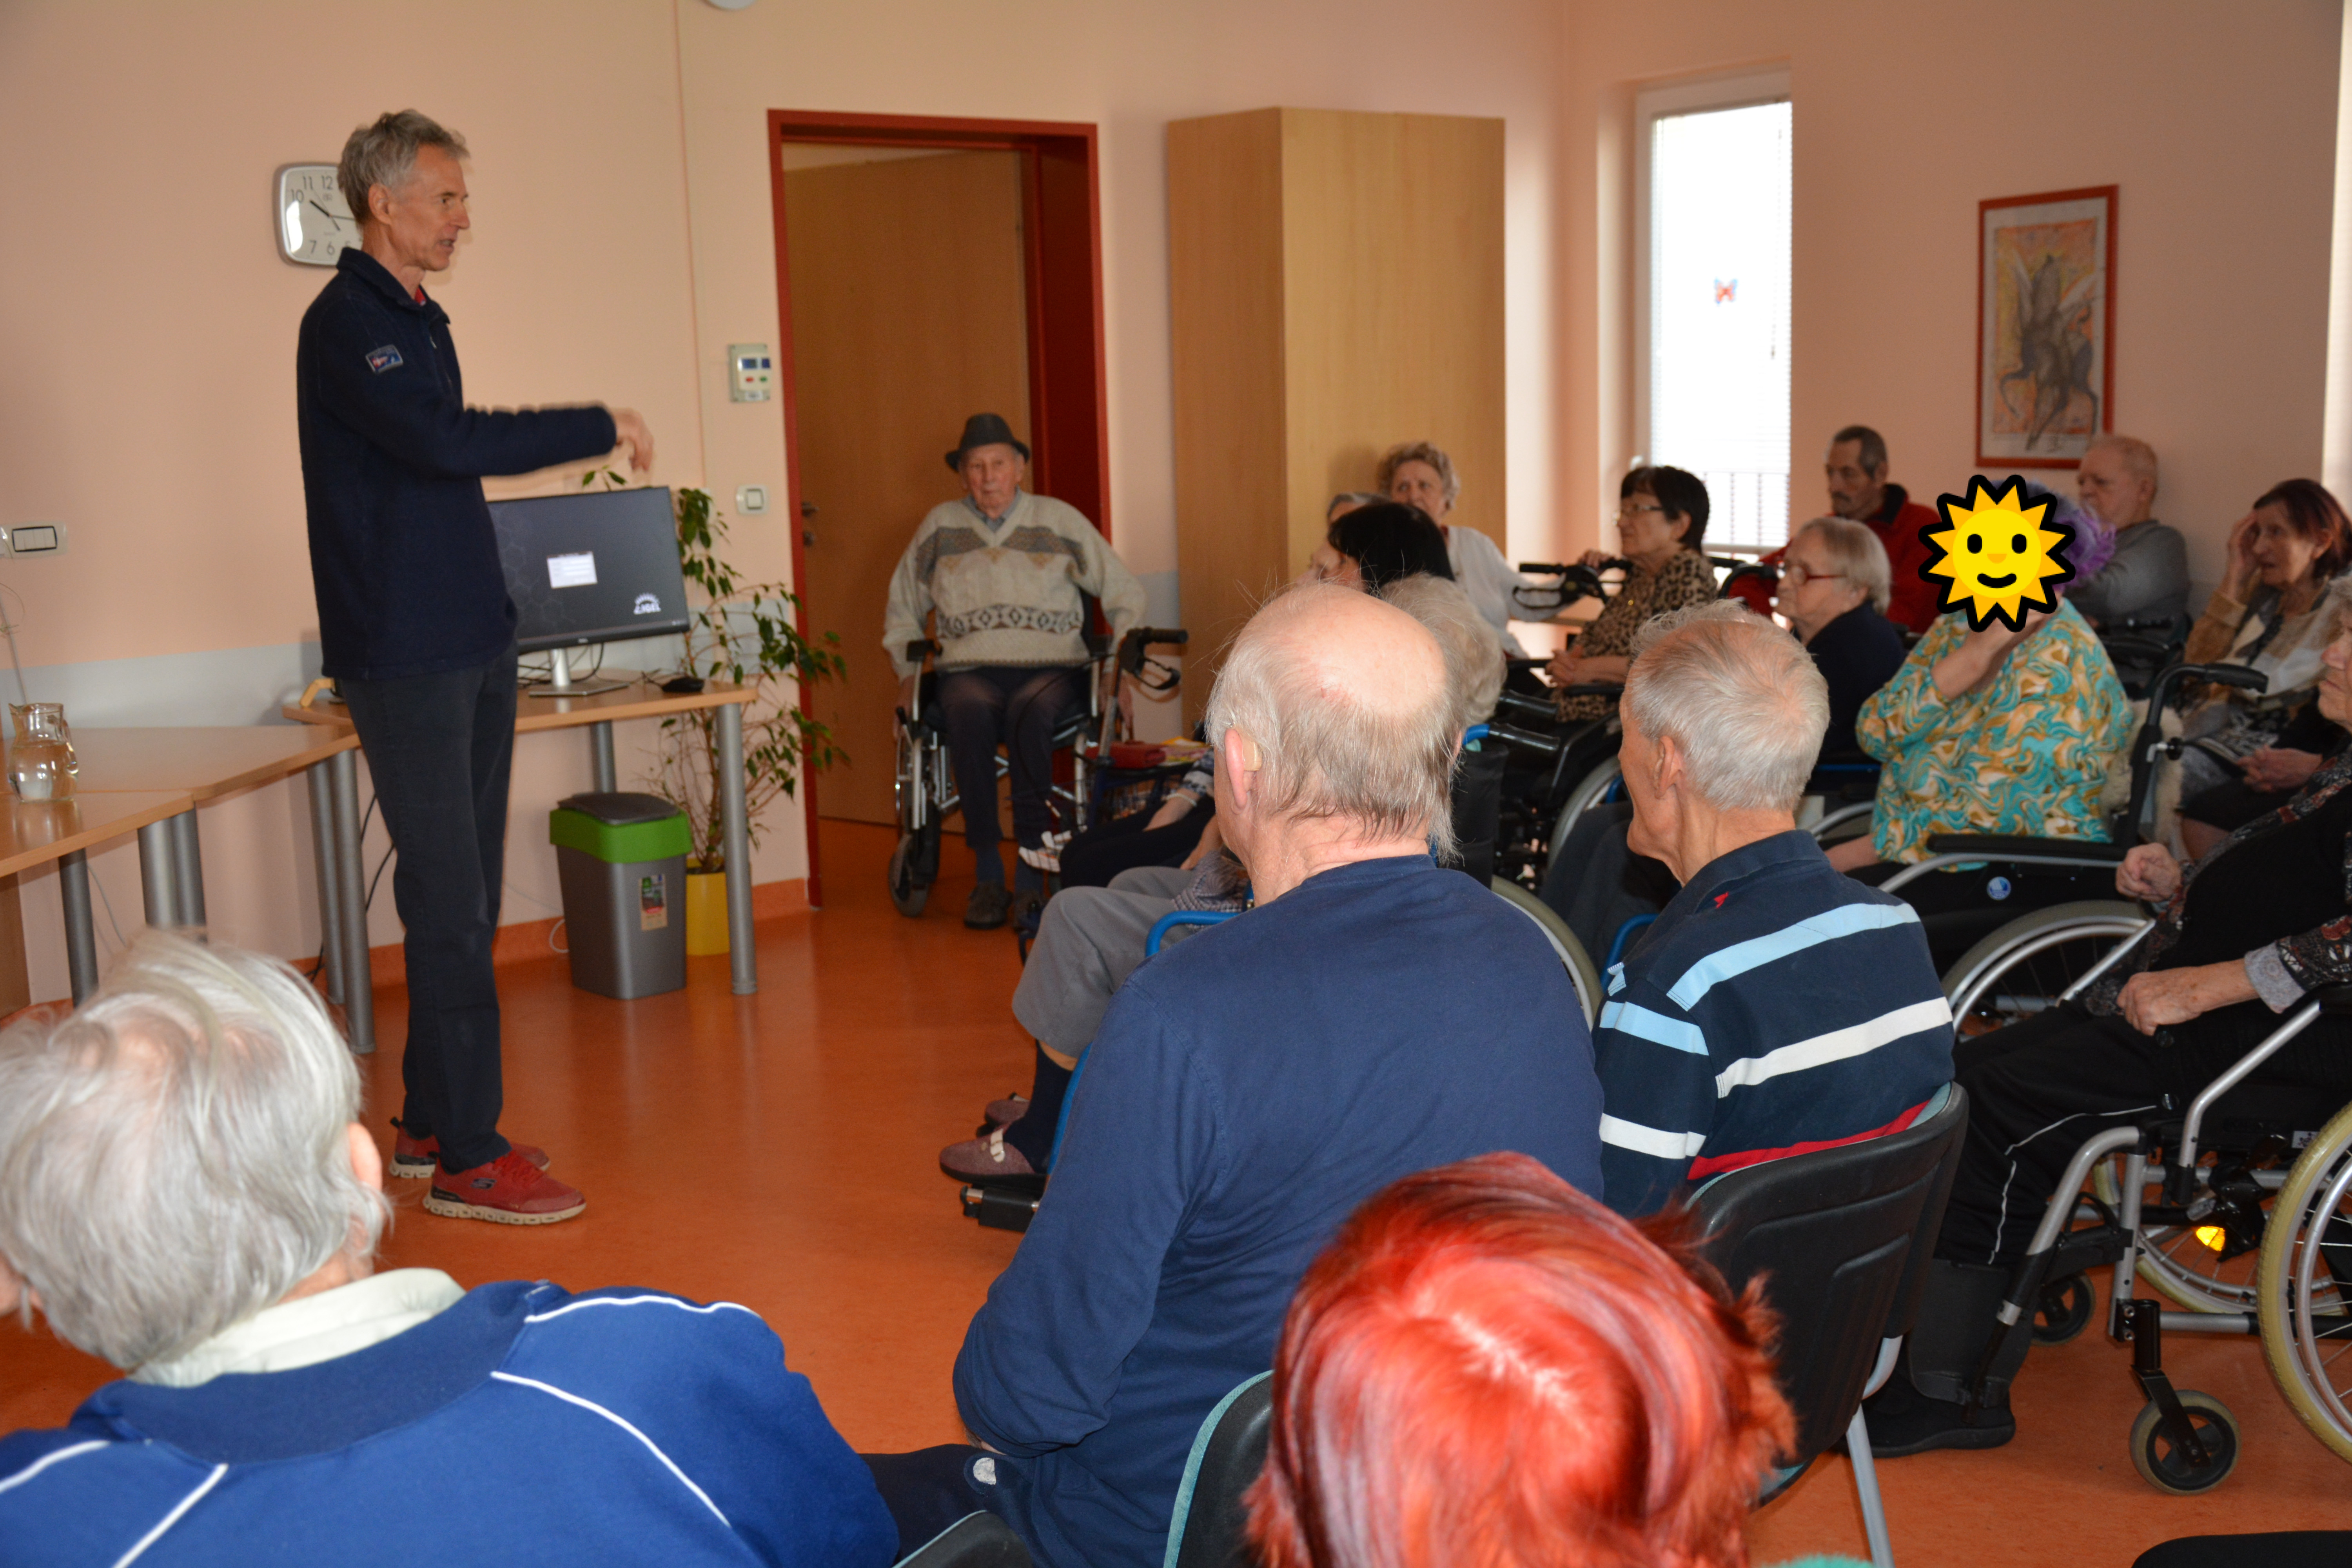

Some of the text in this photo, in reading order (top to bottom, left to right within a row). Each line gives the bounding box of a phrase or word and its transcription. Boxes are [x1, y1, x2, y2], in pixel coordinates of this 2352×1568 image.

[303, 175, 313, 190] 11
[322, 176, 333, 190] 12
[291, 189, 304, 203] 10
[310, 239, 317, 254] 7
[327, 241, 335, 255] 6
